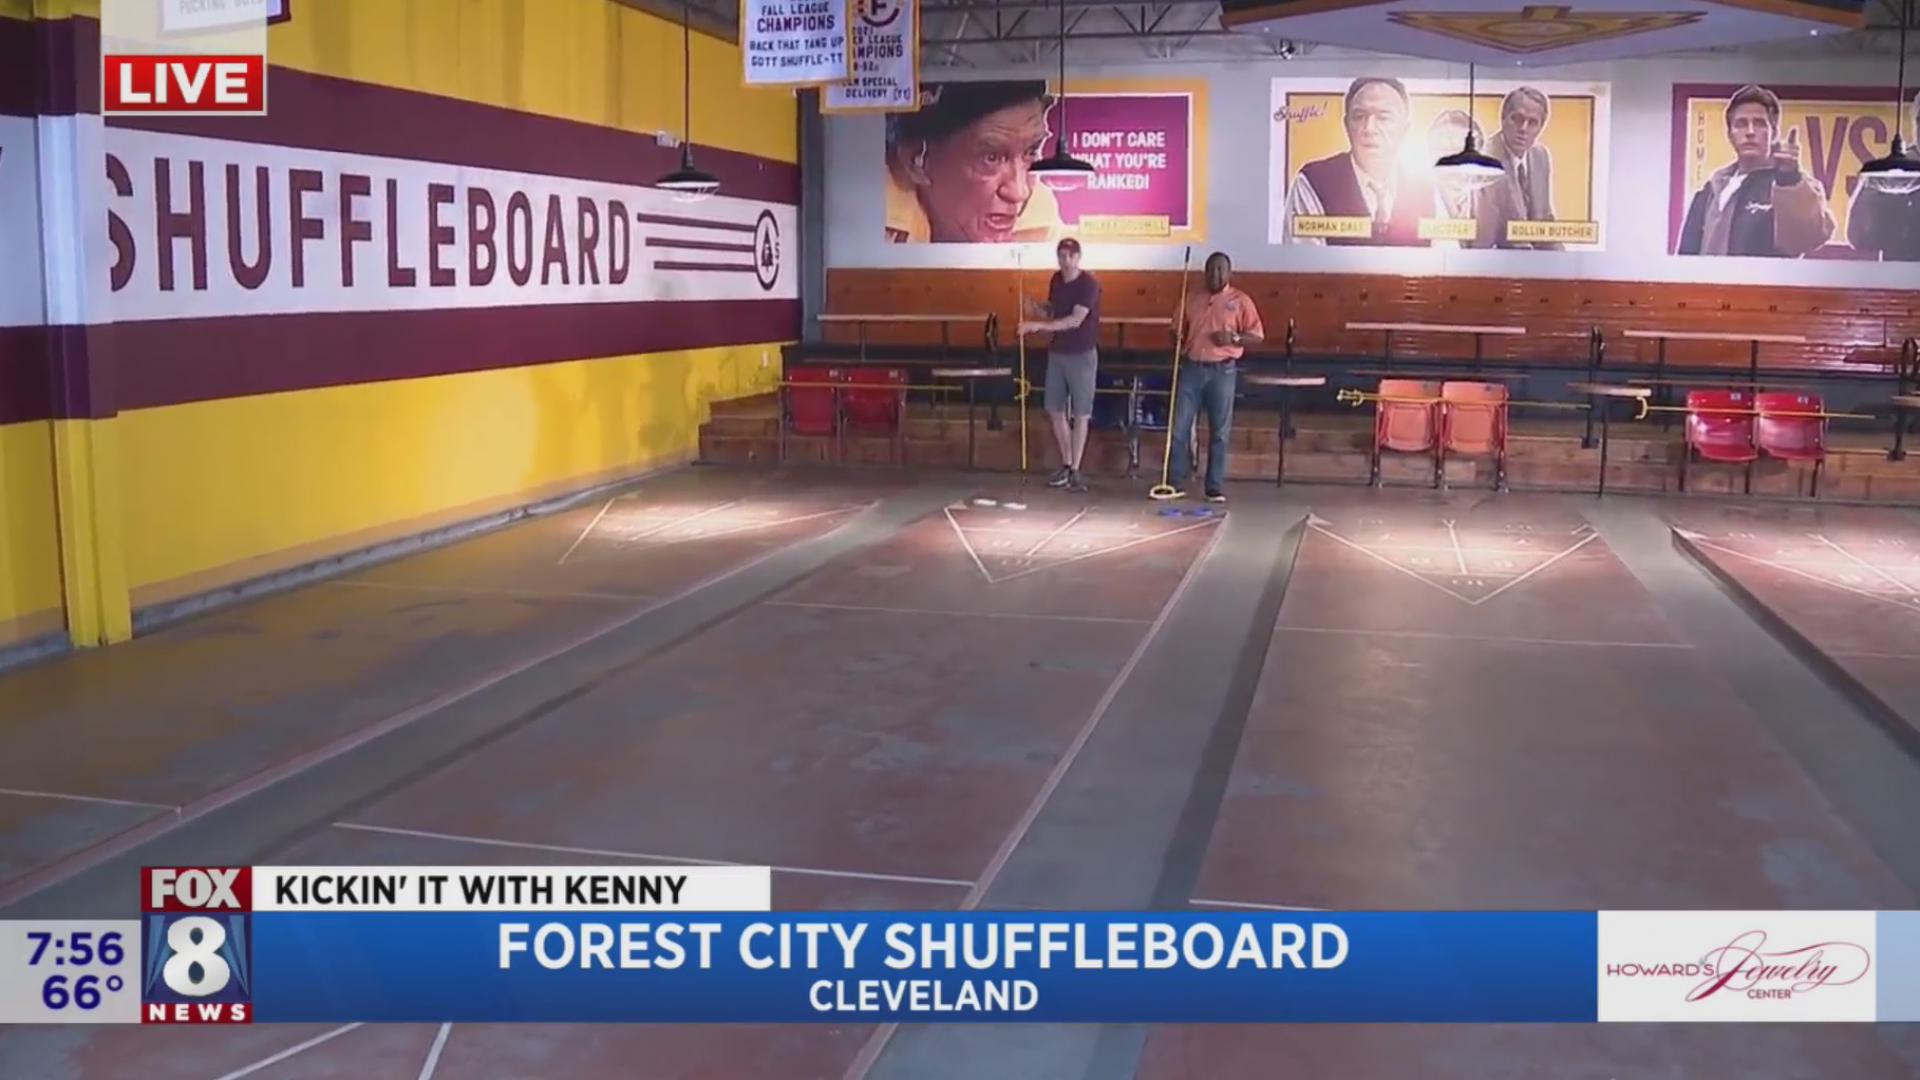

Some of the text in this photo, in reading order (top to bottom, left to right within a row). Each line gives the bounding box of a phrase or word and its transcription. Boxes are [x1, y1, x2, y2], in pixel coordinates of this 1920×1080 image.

[761, 2, 829, 16] FALL LEAGUE
[757, 15, 835, 33] CHAMPIONS
[750, 40, 773, 51] BACK
[778, 40, 799, 51] THAT
[831, 36, 845, 48] UP
[862, 76, 898, 87] SPECIAL
[845, 88, 888, 98] DELIVERY
[1072, 132, 1166, 148] I DON'T CARE
[1115, 153, 1167, 169] YOU'RE
[1805, 115, 1888, 201] VS
[1087, 174, 1150, 190] RANKED!
[105, 152, 630, 292] SHUFFLEBOARD
[1298, 221, 1337, 232] NORMAN
[1511, 225, 1593, 238] ROLLIN BUTCHER
